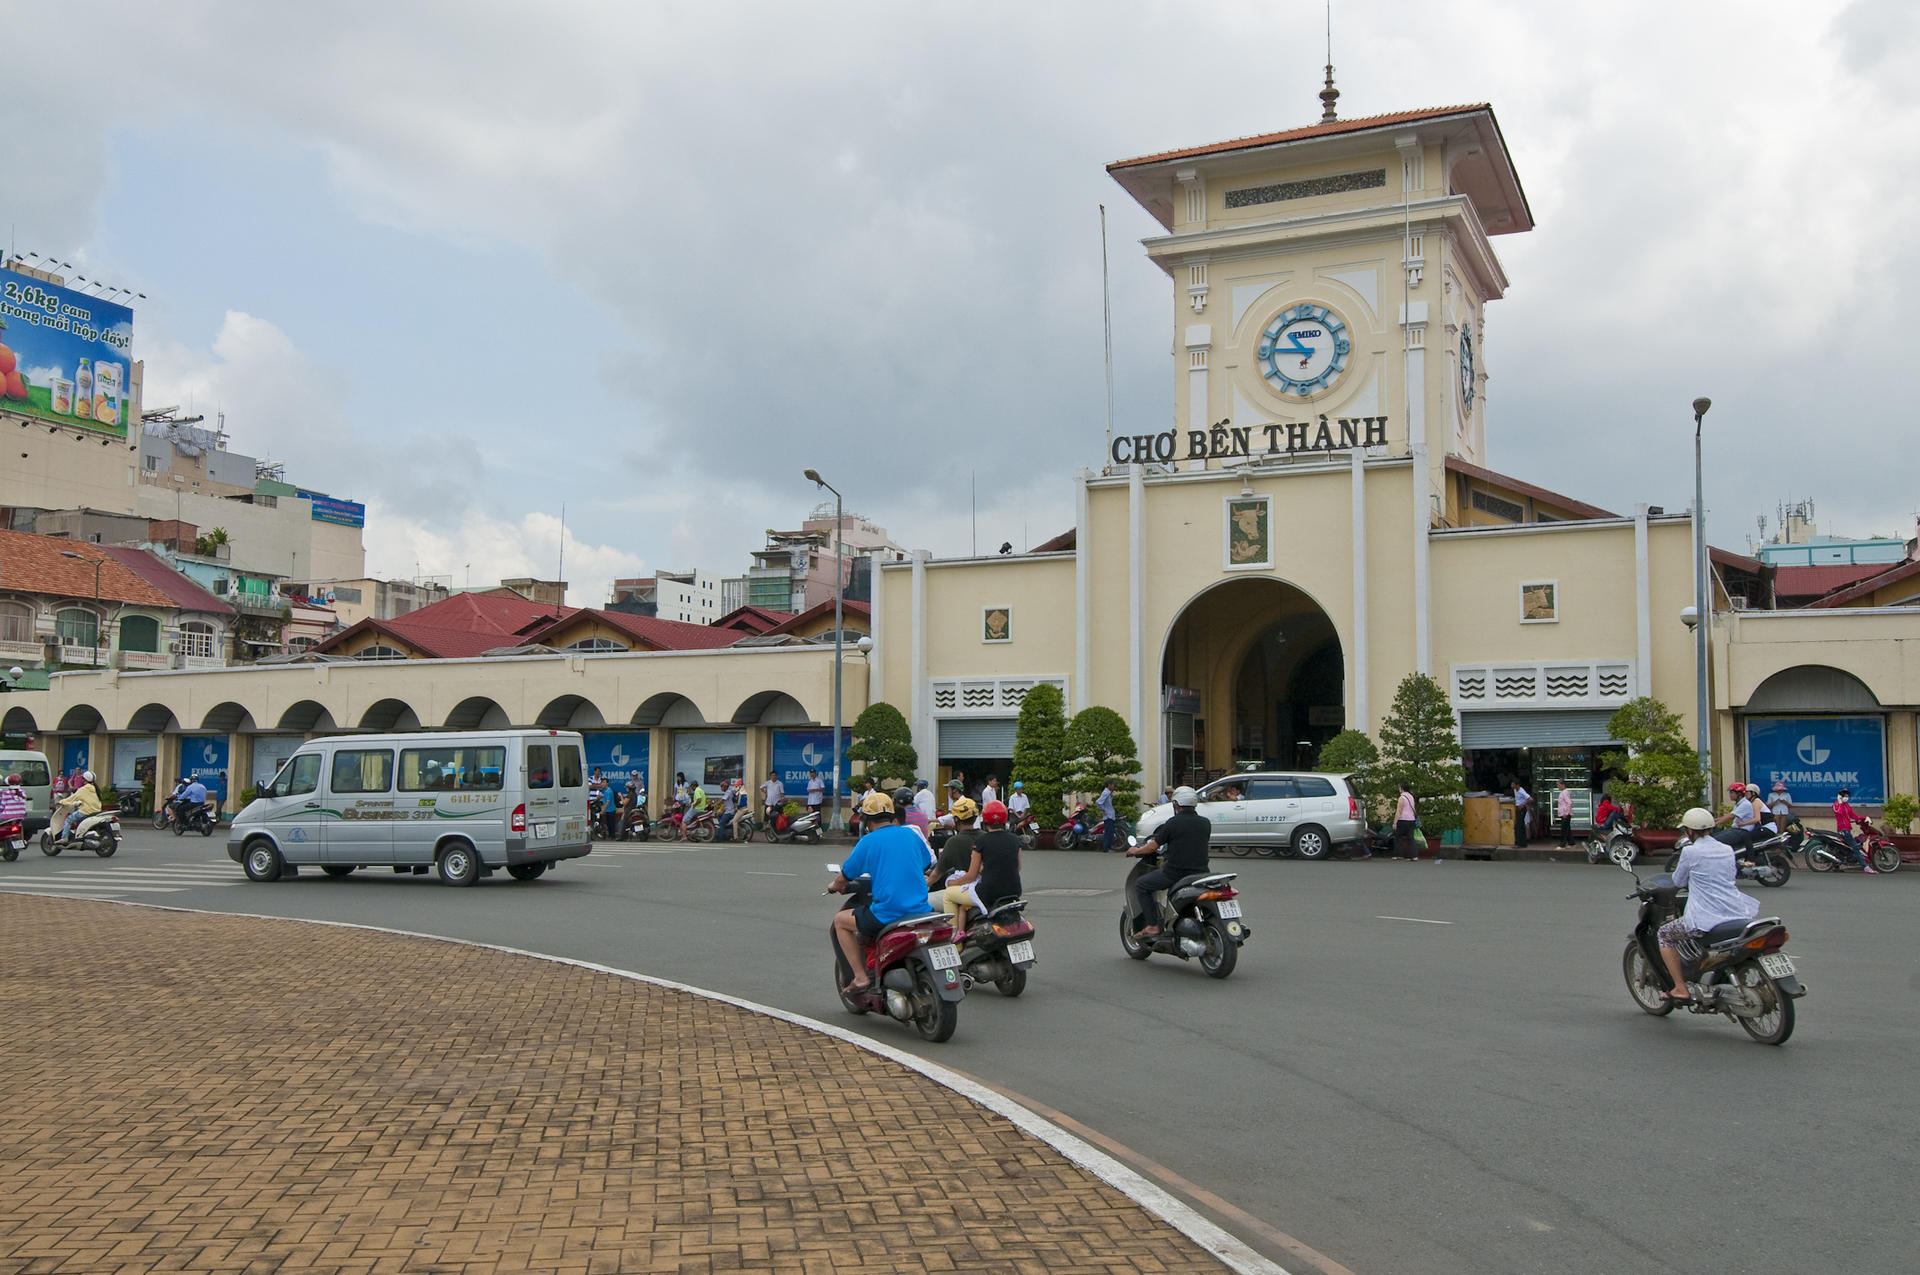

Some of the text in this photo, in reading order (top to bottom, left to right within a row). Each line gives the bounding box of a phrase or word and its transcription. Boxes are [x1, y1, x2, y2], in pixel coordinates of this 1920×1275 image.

[4, 282, 91, 320] 2,6kg cam
[1294, 303, 1314, 320] 12
[0, 302, 129, 349] trong mỗi hộp đấy!
[1112, 414, 1389, 465] CHỢ BẾN THÀNH
[601, 771, 645, 780] XIMBAK
[785, 770, 834, 780] EXIMAN
[1770, 771, 1859, 783] EXIMBANK
[342, 808, 410, 820] BUSINESS
